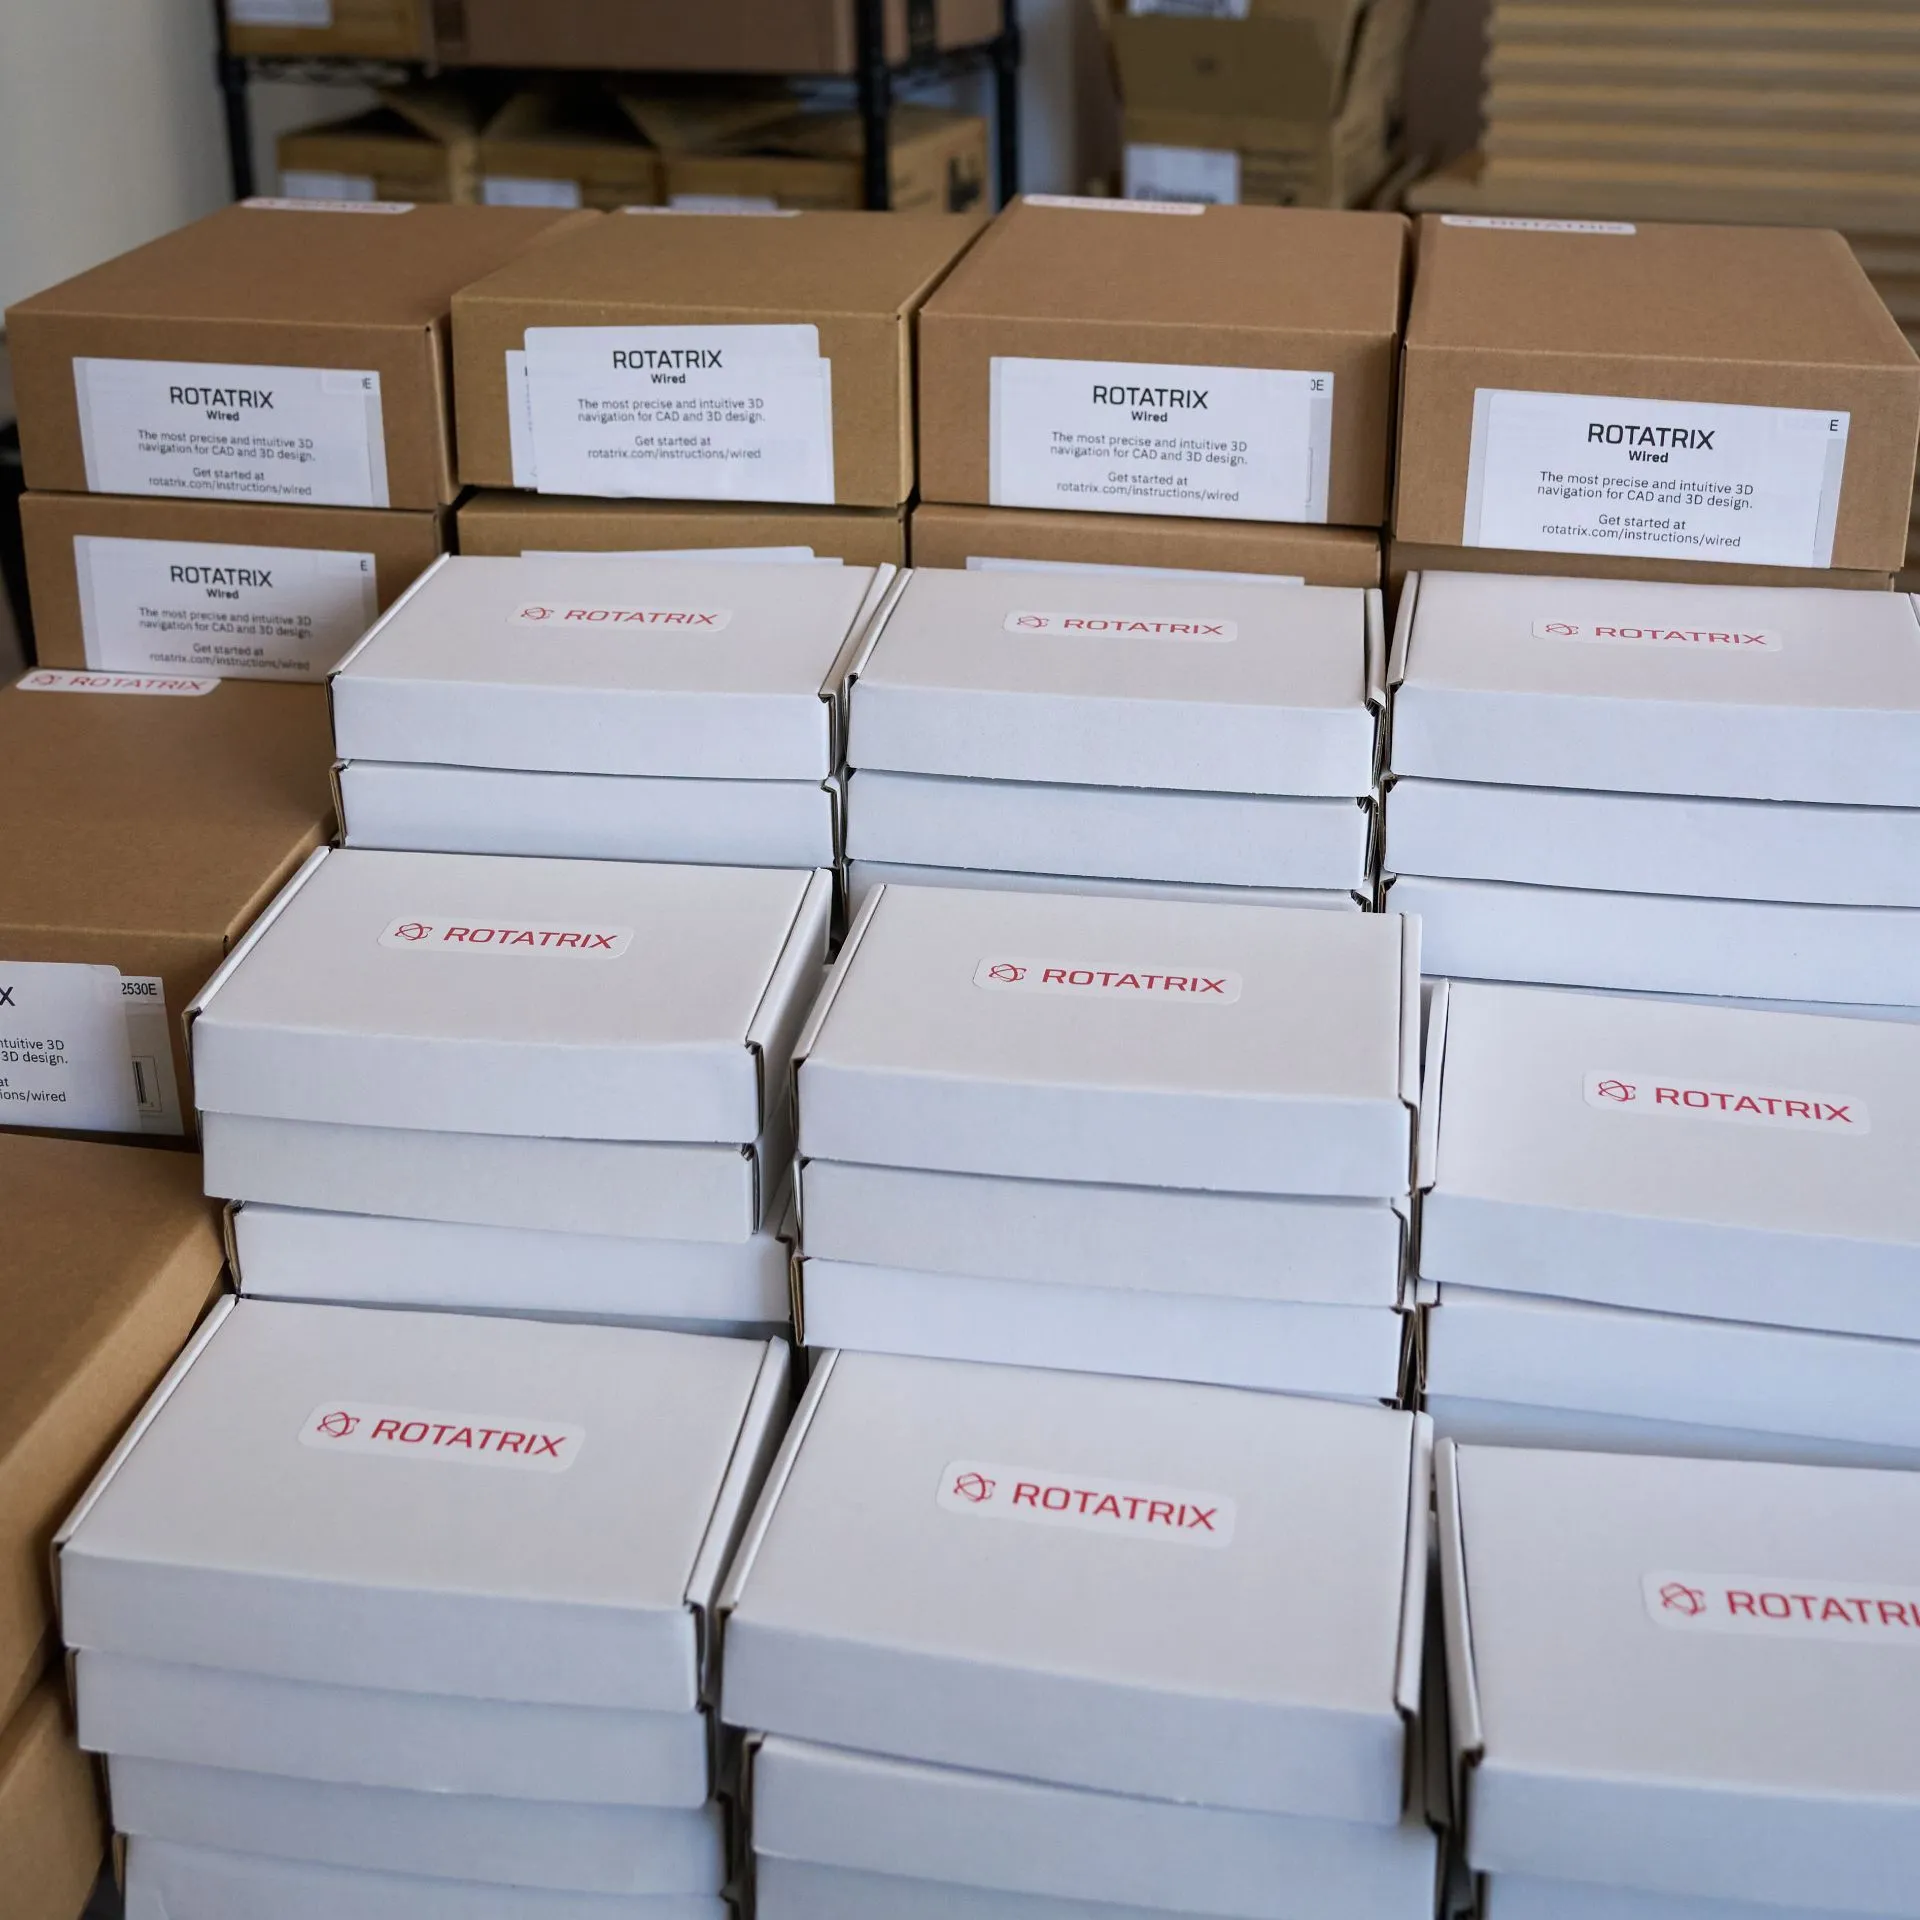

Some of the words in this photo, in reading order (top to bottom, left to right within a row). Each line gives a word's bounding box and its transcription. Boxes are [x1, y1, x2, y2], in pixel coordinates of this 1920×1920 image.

[613, 350, 723, 369] ROTATRIX
[651, 374, 686, 384] Wired
[169, 386, 274, 409] ROTATRIX
[578, 399, 598, 409] The
[602, 400, 629, 409] most
[633, 399, 672, 411] precise
[676, 399, 696, 409] and
[700, 399, 744, 409] intuitive
[748, 399, 764, 409] 3D
[1093, 385, 1208, 409] ROTATRIX
[207, 410, 240, 422] Wired
[578, 412, 634, 424] navigation
[638, 412, 652, 422] for
[656, 412, 679, 422] CAD
[683, 412, 703, 422] and
[707, 412, 721, 422] 3D
[725, 412, 765, 424] design.
[1131, 411, 1168, 423] Wired
[138, 429, 158, 440] The
[161, 432, 187, 442] most
[190, 433, 228, 445] precise
[230, 436, 250, 445] and
[253, 437, 295, 448] intuitive
[298, 438, 313, 449] 3D
[635, 436, 654, 446] Get
[657, 436, 697, 446] started
[700, 437, 711, 446] at
[1052, 432, 1073, 442] The
[1077, 435, 1105, 444] most
[1109, 435, 1151, 448] precise
[1155, 438, 1176, 448] and
[1180, 439, 1227, 451] intuitive
[1231, 441, 1247, 452] 3D
[1588, 423, 1716, 450] ROTATRIX
[138, 441, 192, 455] navigation
[195, 445, 209, 455] for
[212, 446, 234, 456] CAD
[237, 448, 256, 458] and
[260, 449, 274, 458] 3D
[278, 450, 316, 462] design.
[588, 449, 761, 460] rotatrix.com/instructions/wired
[1050, 445, 1110, 458] navigation
[1114, 447, 1128, 457] for
[1132, 449, 1158, 459] CAD
[1161, 451, 1182, 461] and
[1186, 452, 1202, 462] 3D
[1205, 453, 1248, 466] design.
[1628, 451, 1668, 463] Wired
[193, 468, 211, 477] Get
[214, 470, 251, 480] started
[255, 472, 265, 480] at
[1108, 472, 1128, 483] Get
[1132, 474, 1173, 485] started
[1177, 477, 1188, 486] at
[1540, 471, 1563, 483] The
[1568, 474, 1598, 485] most
[1602, 477, 1649, 489] precise
[1652, 479, 1676, 490] and
[1680, 480, 1732, 494] intuitive
[1736, 484, 1754, 495] 3D
[149, 477, 312, 495] rotatrix.com/instructions/wired
[1057, 482, 1239, 501] rotatrix.com/instructions/wired
[1538, 485, 1602, 498] navigation
[1607, 488, 1624, 500] for
[1627, 490, 1654, 502] CAD
[1658, 493, 1681, 504] and
[1685, 494, 1703, 505] 3D
[1707, 496, 1753, 511] design.
[1599, 514, 1620, 525] Get
[1624, 517, 1670, 529] started
[1673, 520, 1686, 529] at
[1542, 524, 1741, 547] rotatrix.com/instructions/wired
[170, 565, 273, 587] ROTATRIX
[207, 589, 239, 599] Wired
[139, 608, 158, 617] The
[162, 609, 187, 619] most
[191, 610, 228, 622] precise
[230, 613, 249, 622] and
[252, 614, 293, 625] intuitive
[297, 616, 311, 626] 3D
[563, 609, 718, 625] ROTATRIX
[139, 620, 192, 631] navigation
[195, 622, 208, 631] for
[212, 623, 234, 633] CAD
[237, 625, 256, 634] and
[259, 625, 273, 635] 3D
[1063, 618, 1224, 636] ROTATRIX
[1595, 626, 1766, 645] ROTATRIX
[193, 642, 211, 653] Get
[214, 646, 251, 656] started
[254, 648, 263, 656] at
[68, 677, 207, 690] ROTATRIX
[443, 927, 617, 949] ROTATRIX
[122, 983, 157, 995] 2530E
[1042, 969, 1227, 993] ROTATRIX
[47, 1040, 65, 1051] 3D
[2, 1051, 19, 1062] 3D
[23, 1052, 68, 1066] design.
[1655, 1087, 1854, 1123] ROTATRIX
[371, 1419, 567, 1457] ROTATRIX
[1012, 1482, 1218, 1531] ROTATRIX
